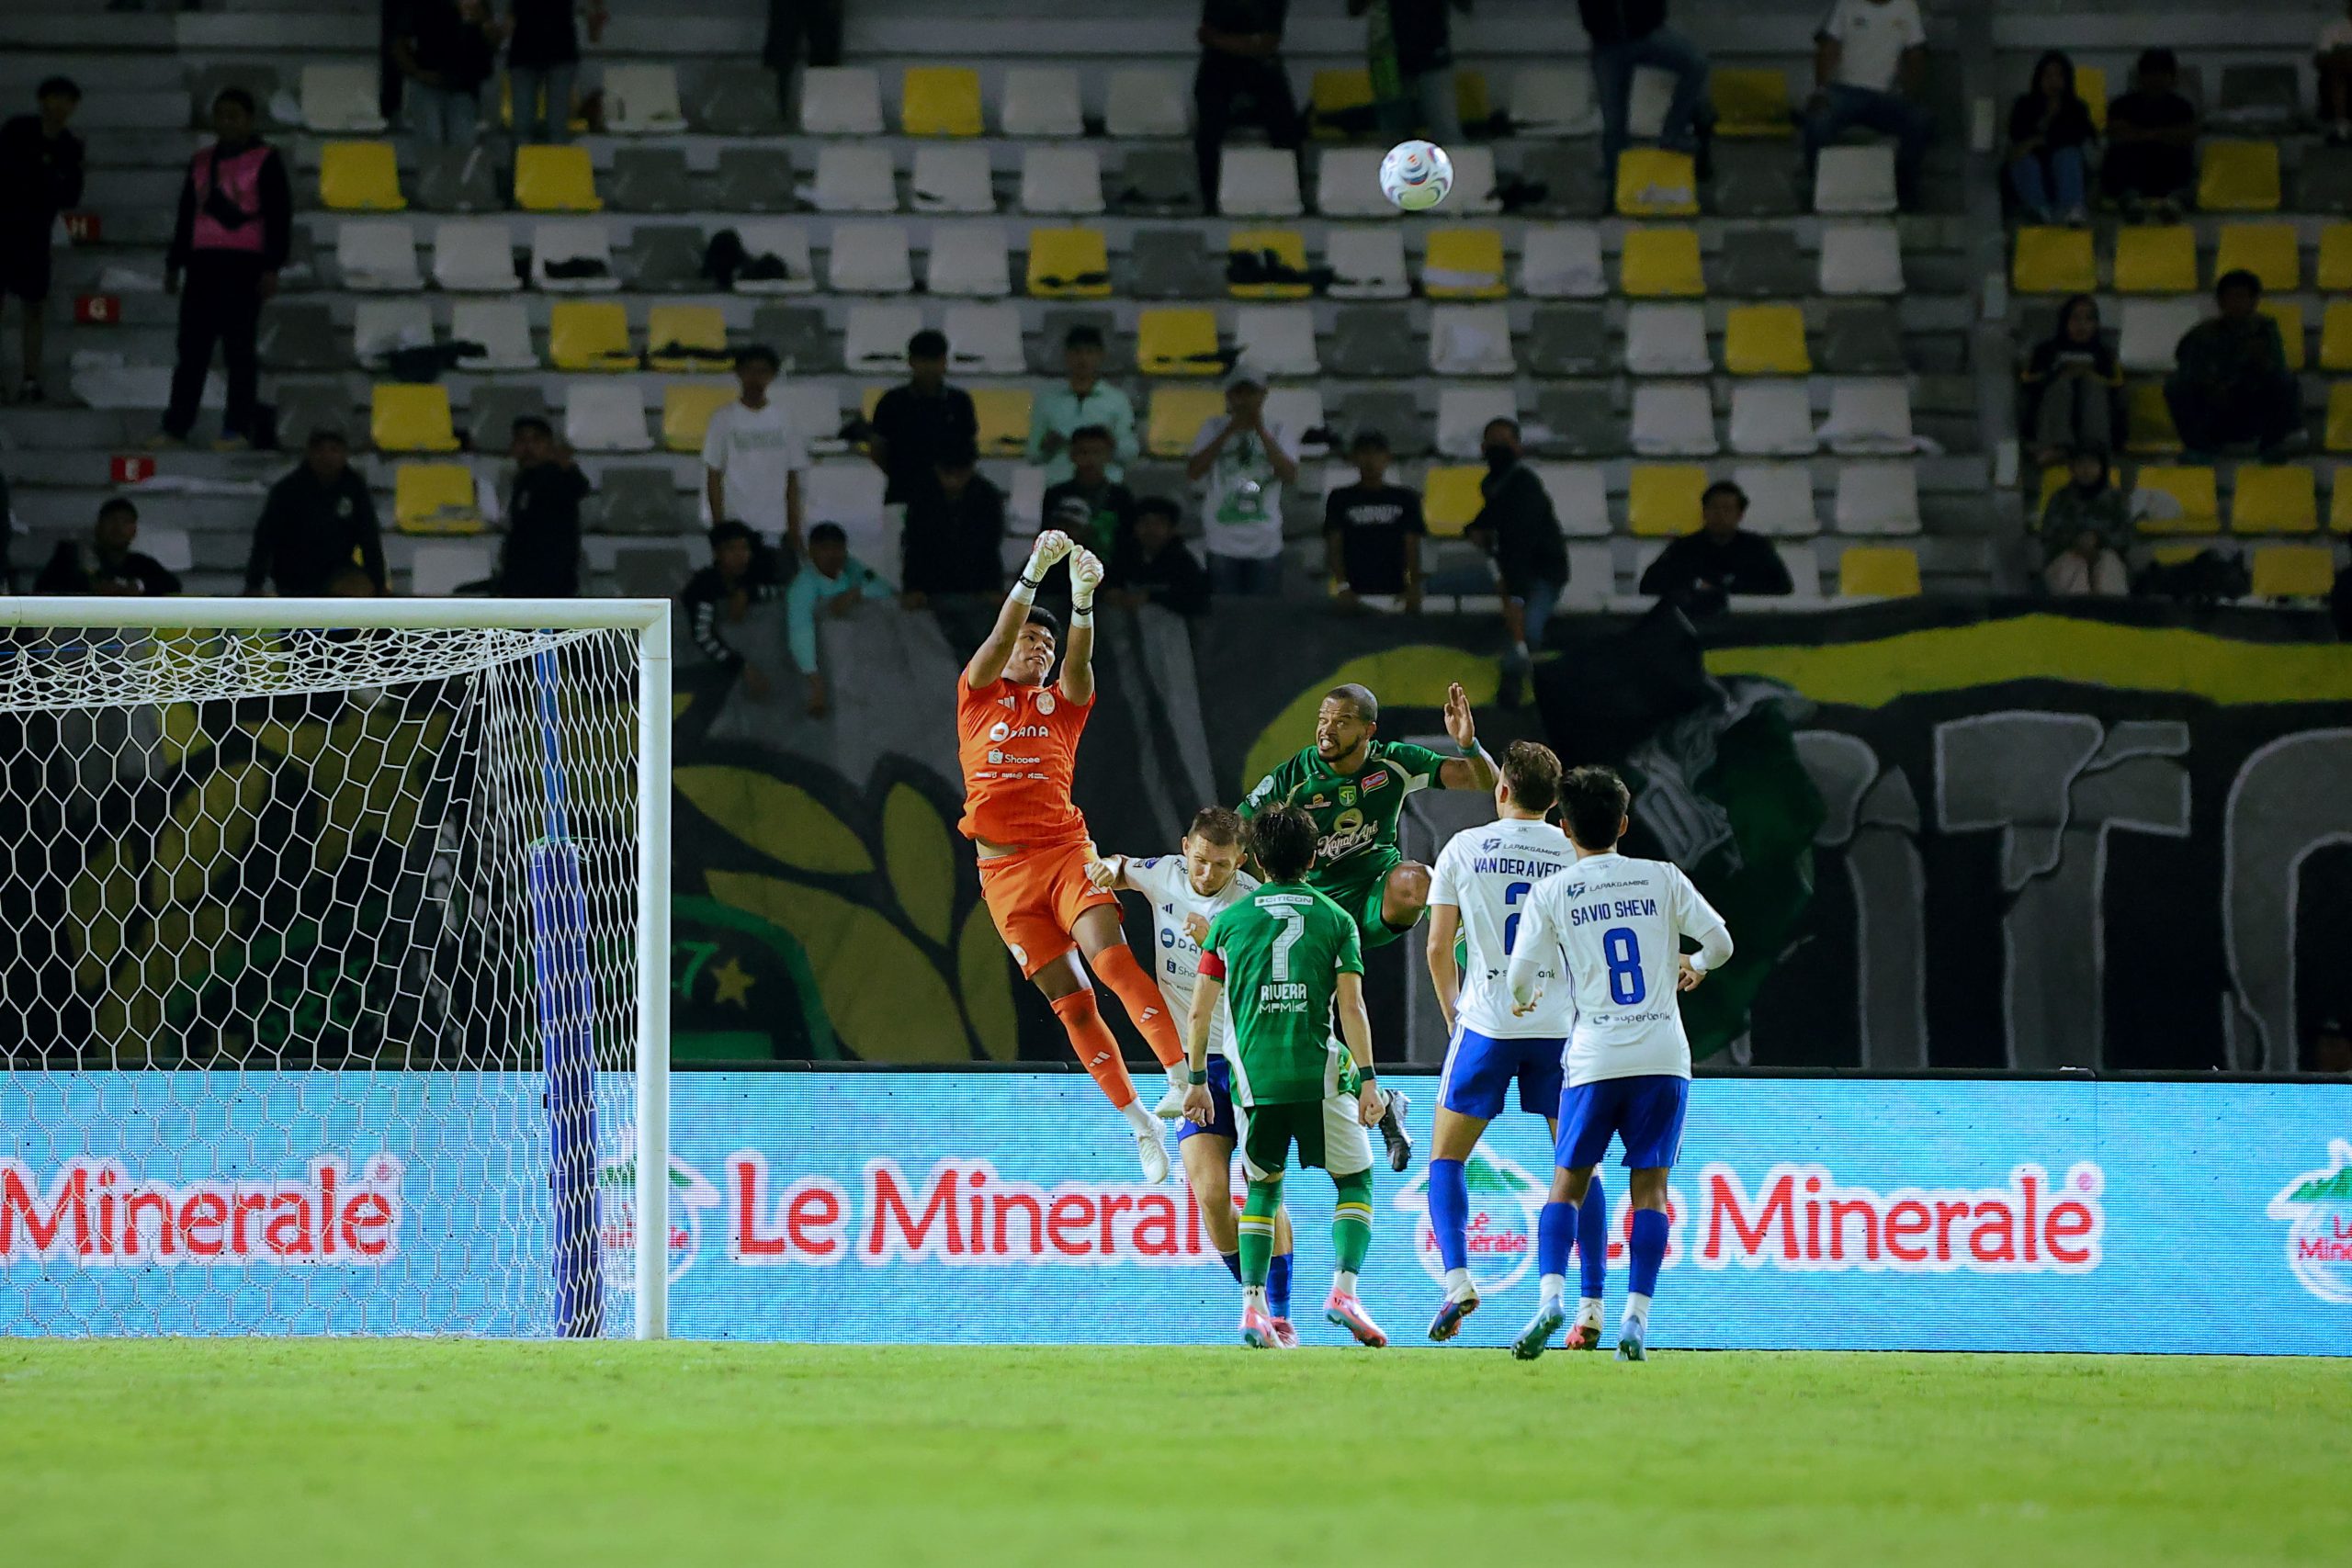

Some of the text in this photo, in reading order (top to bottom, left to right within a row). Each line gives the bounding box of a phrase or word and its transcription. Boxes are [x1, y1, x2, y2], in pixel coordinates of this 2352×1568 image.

[1317, 831, 1357, 859] Kapal
[1503, 844, 1561, 857] LAPAKGAMING
[1474, 857, 1567, 878] VAN DER AVER
[1235, 878, 1255, 893] Grab
[1589, 879, 1649, 891] LAPAKGAMING
[1265, 896, 1312, 904] CITICON
[1571, 898, 1658, 926] SAVIO SHEVA
[1263, 904, 1305, 982] 7
[1602, 927, 1645, 1005] 8
[1261, 983, 1307, 1001] RIVERA
[738, 1162, 840, 1256] Le
[868, 1168, 1246, 1257] Mineral
[1703, 1174, 2094, 1264] Minerale
